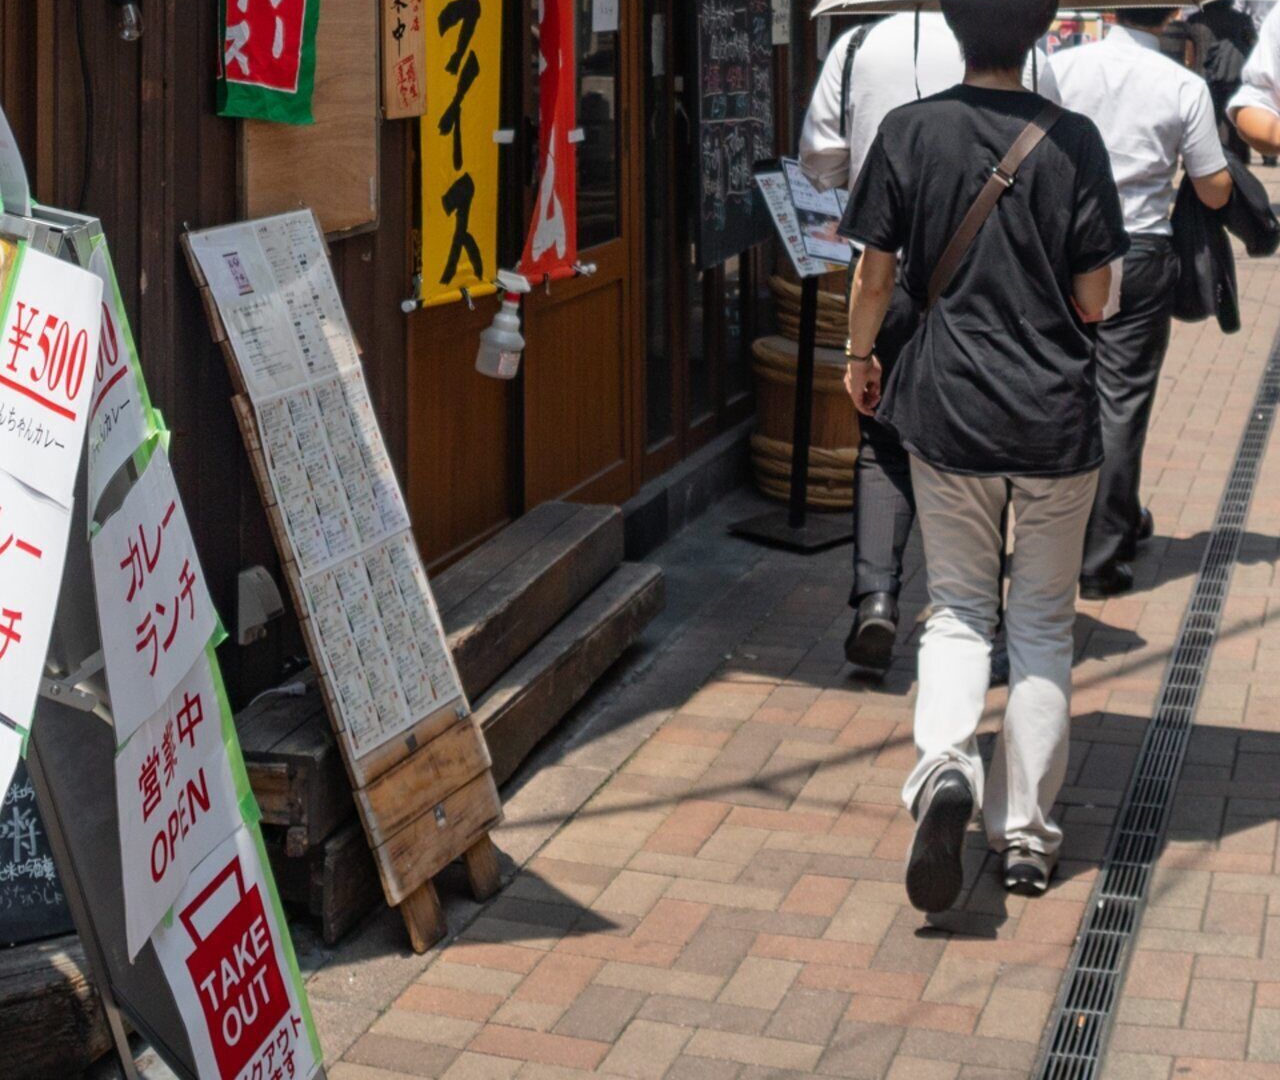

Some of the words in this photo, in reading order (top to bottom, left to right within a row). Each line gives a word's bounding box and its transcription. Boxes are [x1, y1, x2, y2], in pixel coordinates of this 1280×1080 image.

[6, 301, 89, 402] ¥500
[120, 501, 176, 603] カレー
[136, 560, 197, 677] ランチ
[138, 692, 204, 824] 営業中
[150, 767, 211, 884] OPEN
[200, 915, 270, 1012] TAKE
[222, 964, 271, 1047] OUT
